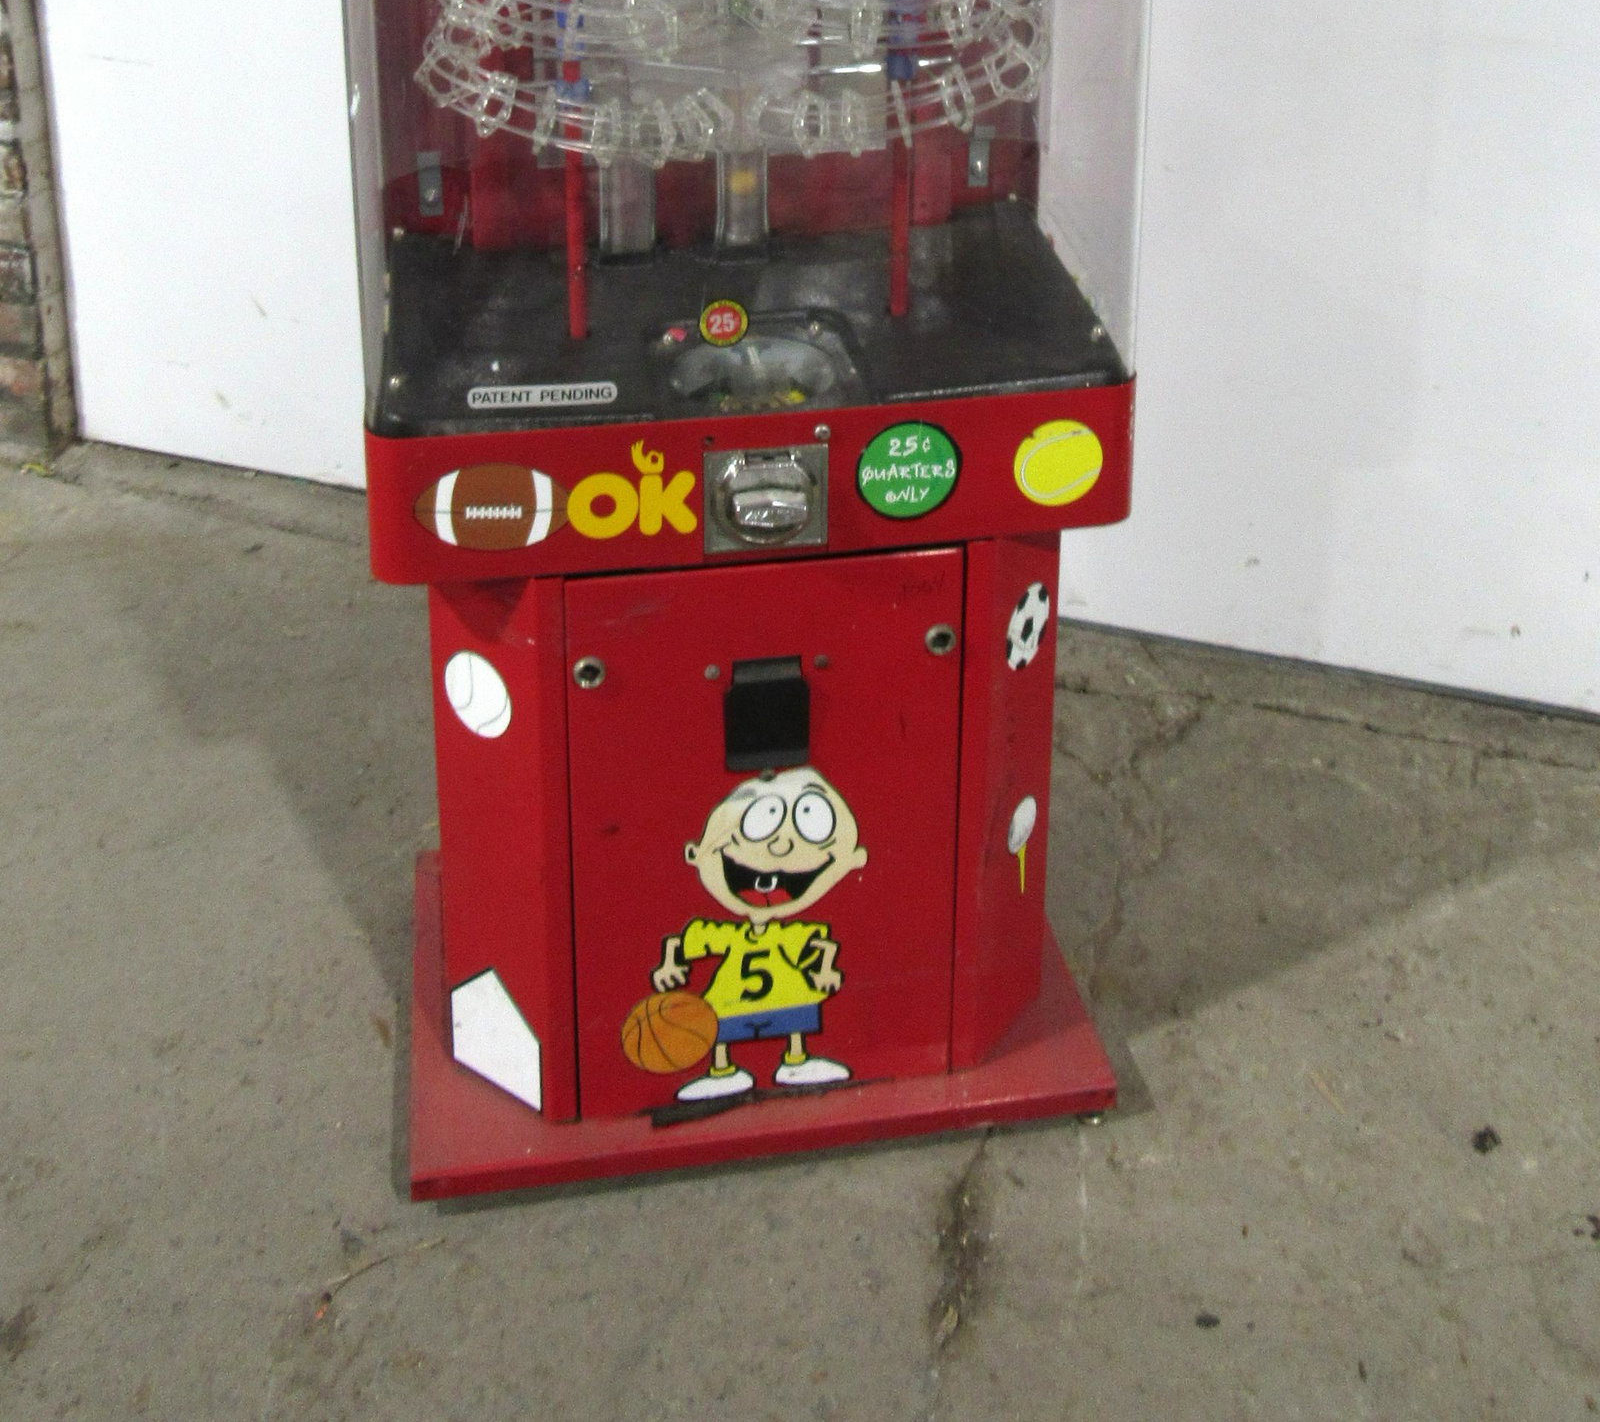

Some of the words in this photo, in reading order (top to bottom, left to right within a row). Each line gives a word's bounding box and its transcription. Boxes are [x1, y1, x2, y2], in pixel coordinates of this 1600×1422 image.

[471, 389, 533, 405] PATENT
[539, 385, 613, 403] PENDING
[861, 458, 956, 486] QUARTERS
[566, 469, 699, 540] OK
[885, 484, 930, 504] ONLY
[739, 948, 774, 1003] 5
